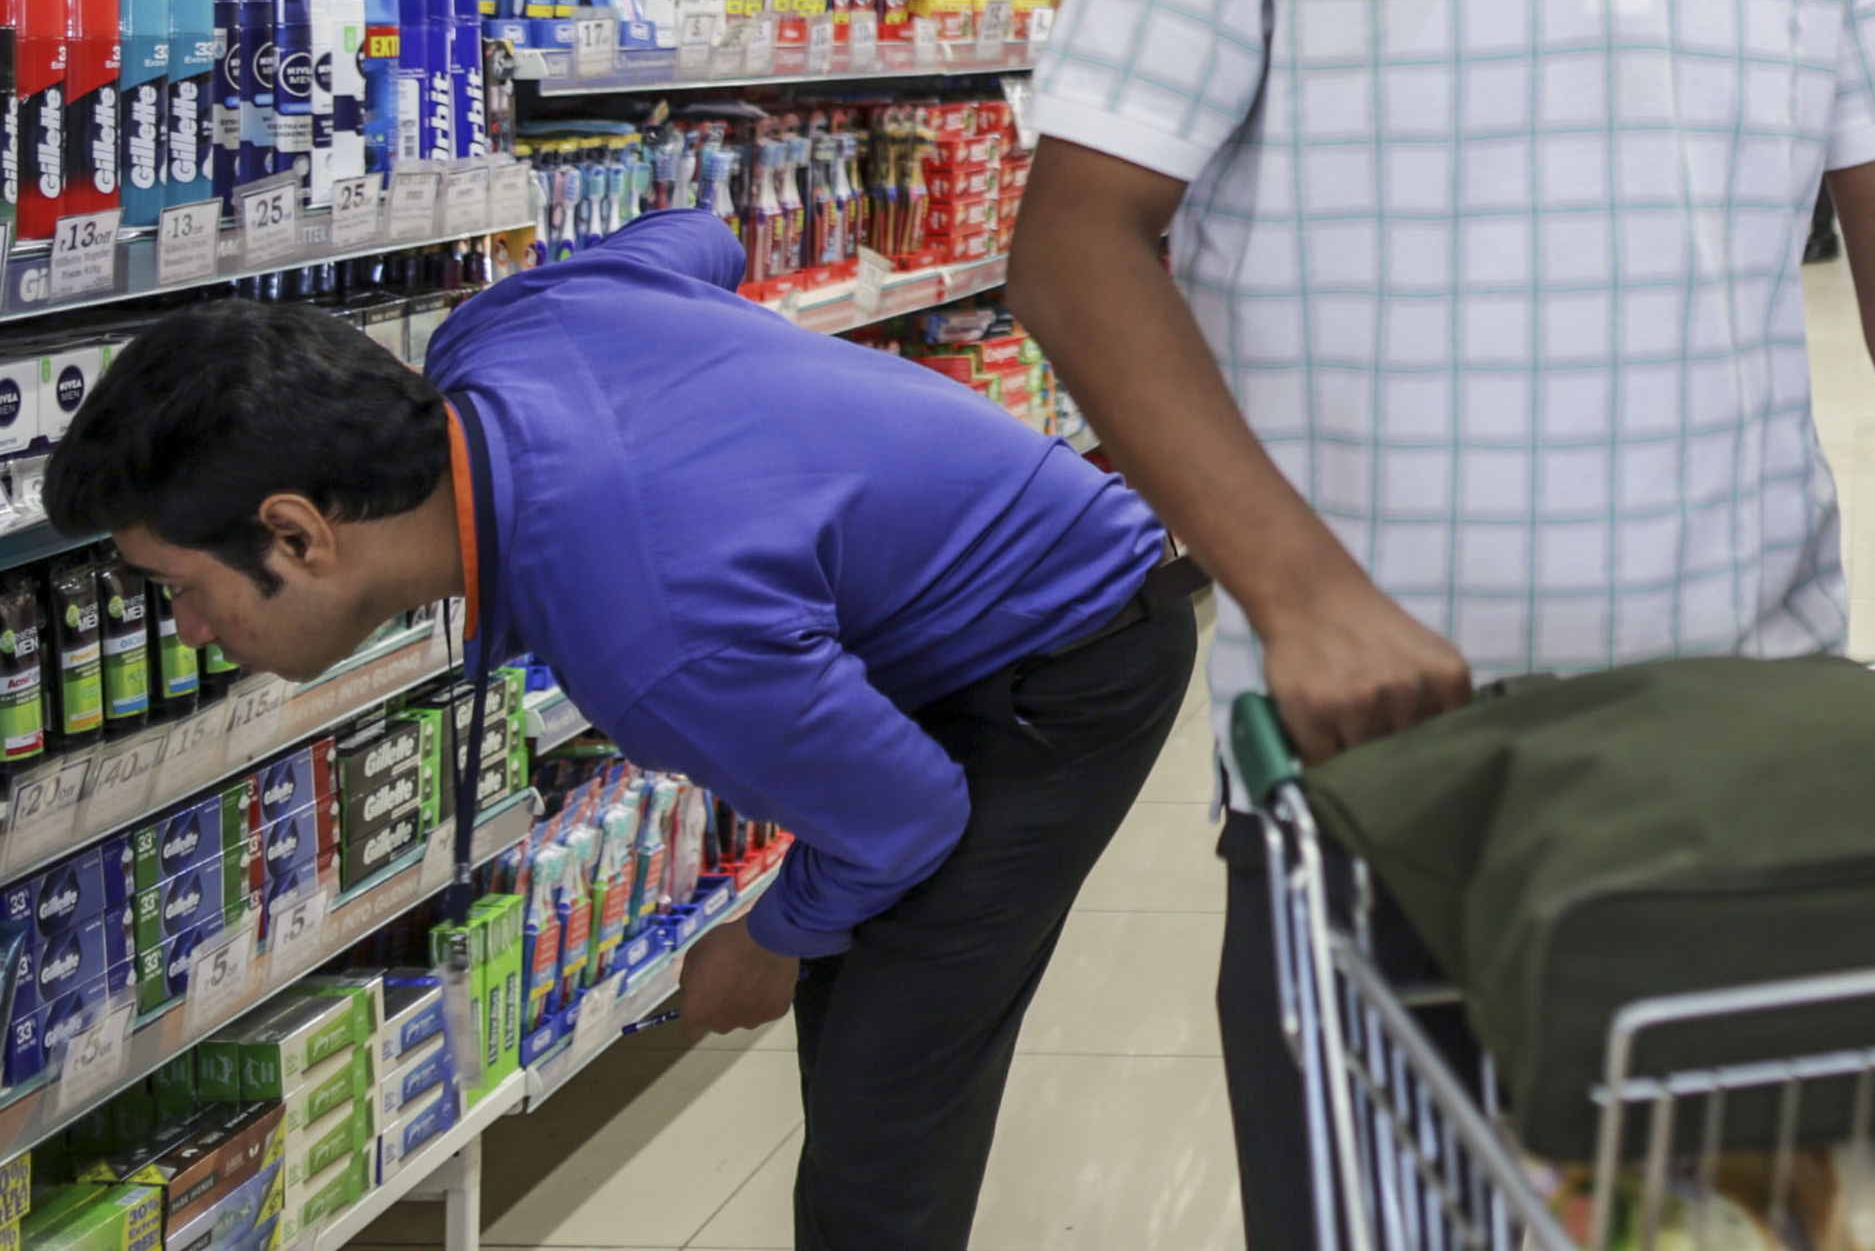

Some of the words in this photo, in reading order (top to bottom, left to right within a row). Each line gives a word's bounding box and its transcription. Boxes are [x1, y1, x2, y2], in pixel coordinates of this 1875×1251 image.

[38, 88, 61, 199] Gillette
[93, 86, 116, 194] Gillette
[130, 85, 157, 190] Gillette
[170, 81, 198, 183] Gillette
[59, 379, 82, 391] NIVEA
[61, 390, 80, 401] MEN
[15, 636, 39, 658] MEN
[364, 734, 415, 778] Gillette
[264, 781, 294, 806] Gillette
[364, 777, 414, 822] Gillette
[163, 832, 199, 859] Gillette
[267, 836, 298, 861] Gillette
[364, 822, 413, 866] Gillette
[39, 889, 79, 920] Gillette
[165, 891, 201, 920] Gillette
[40, 953, 81, 985] Gillette
[129, 1199, 159, 1222] 30%
